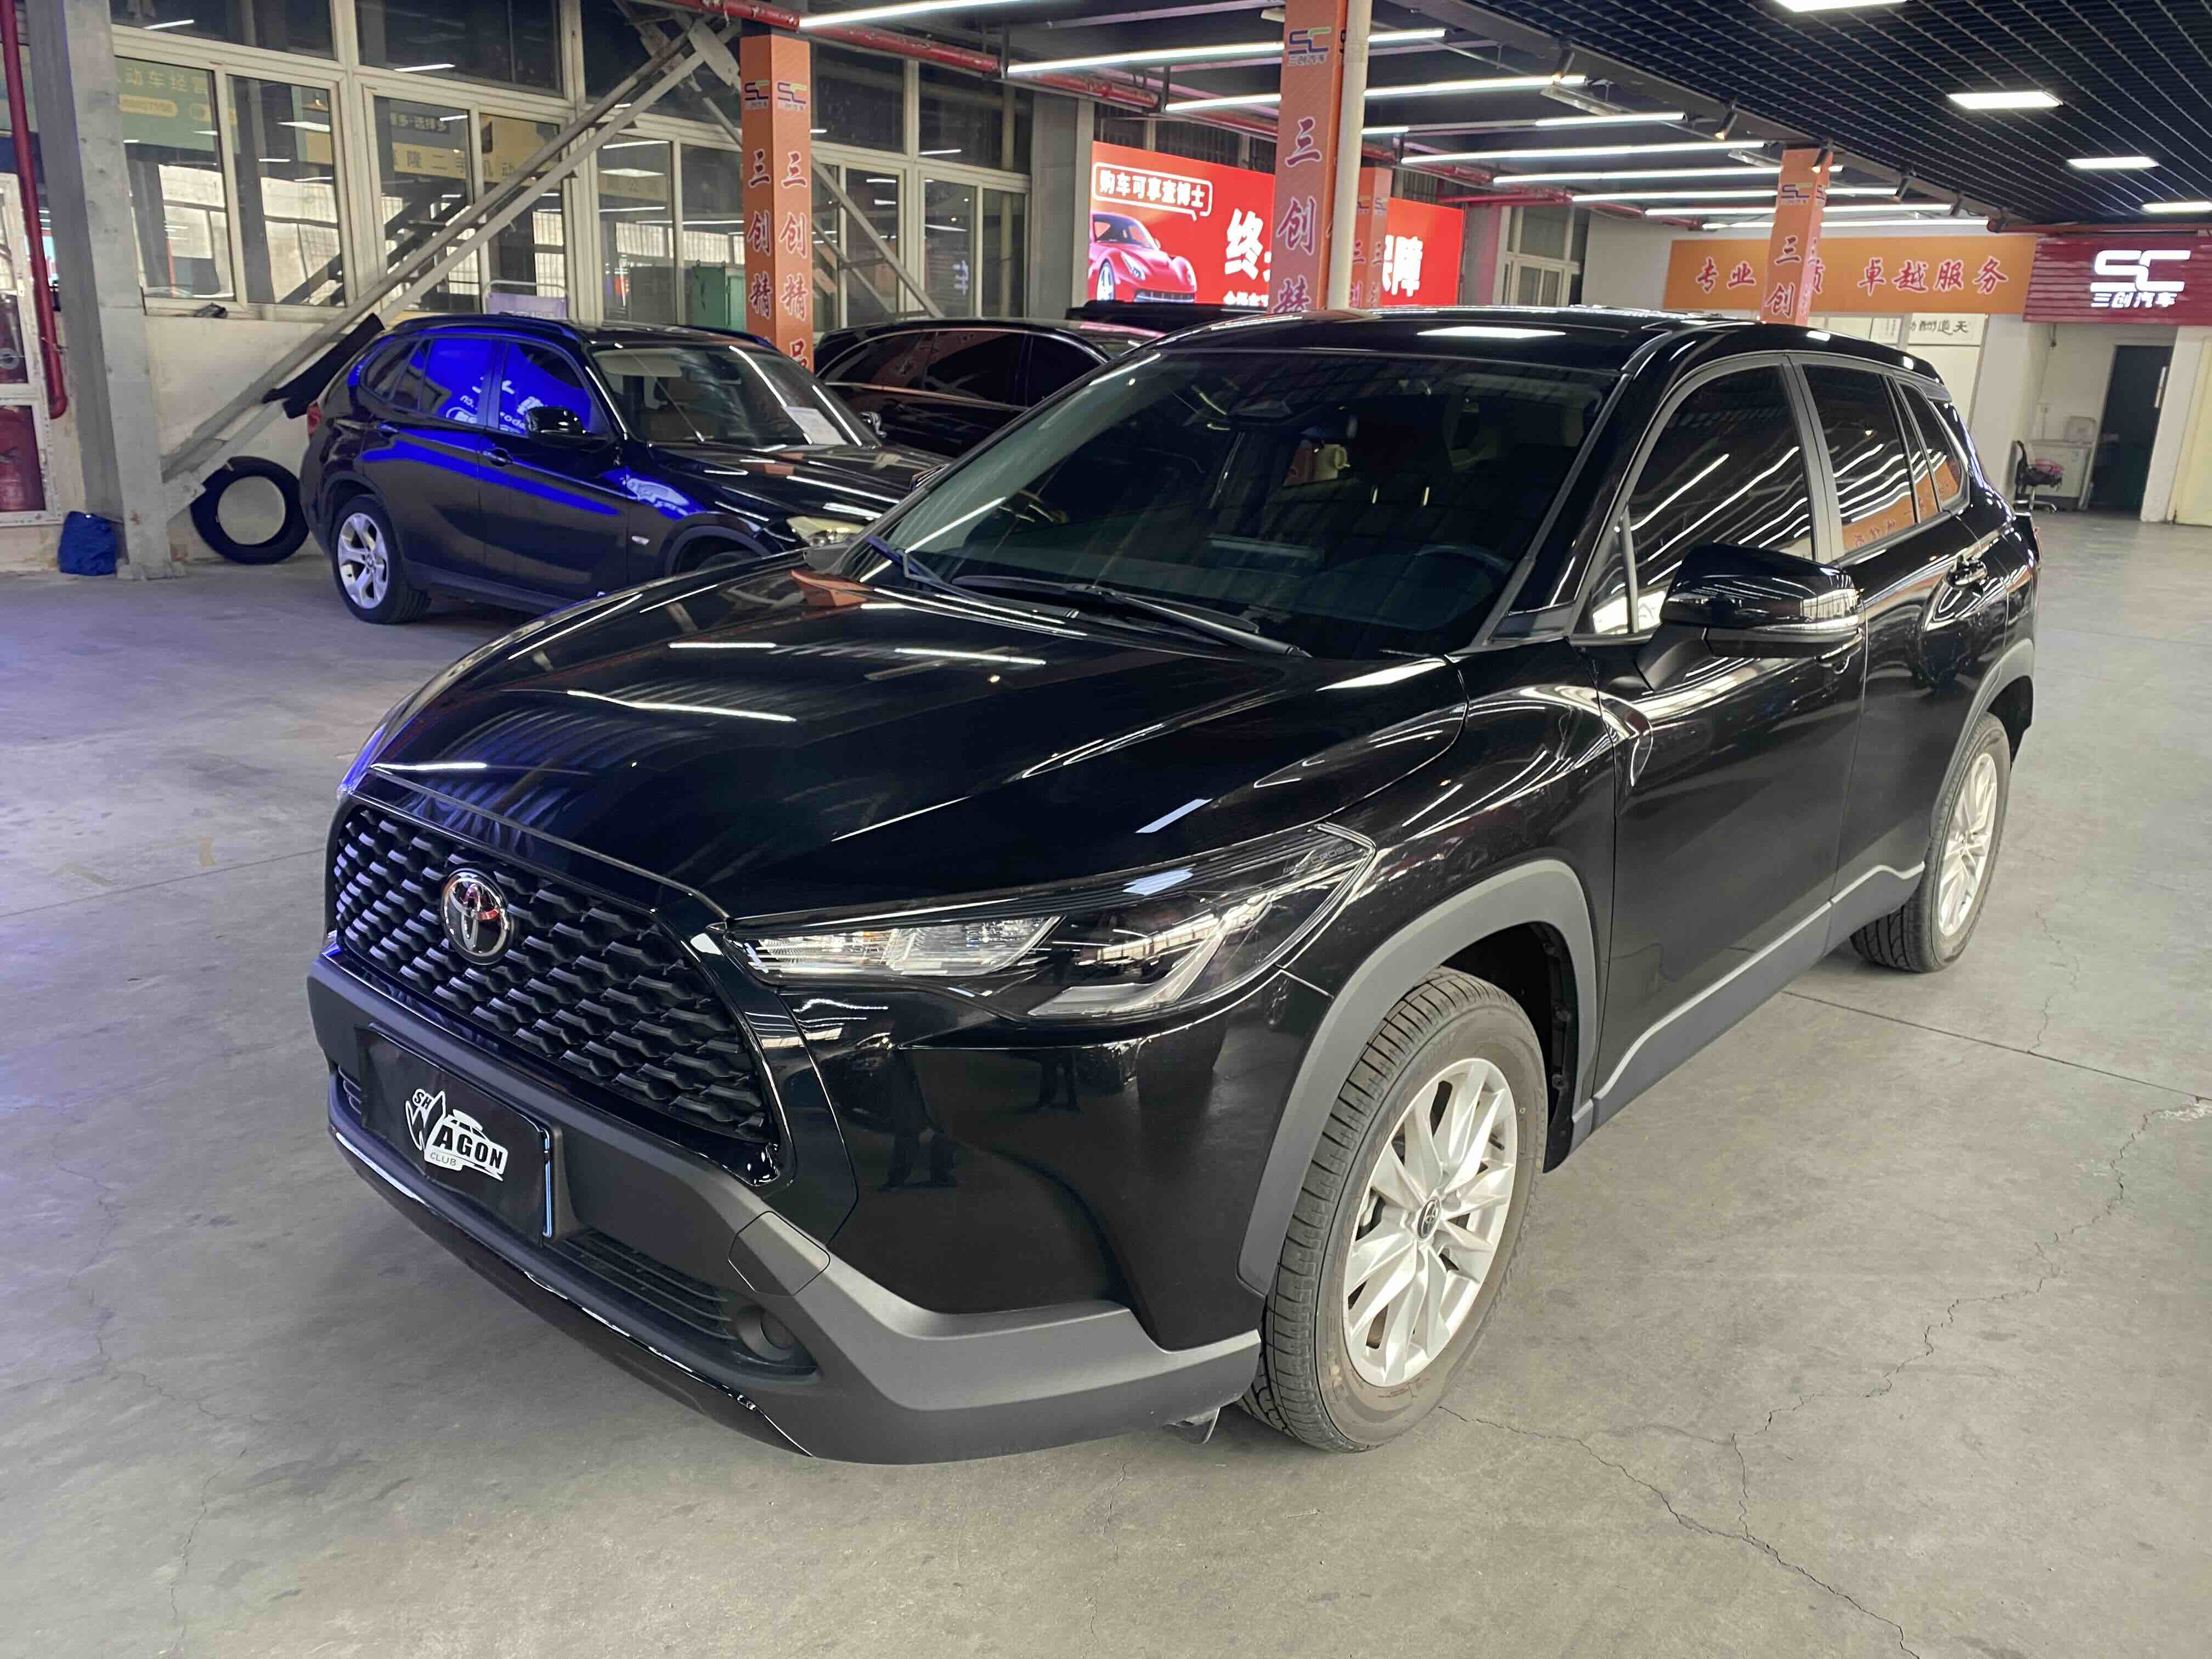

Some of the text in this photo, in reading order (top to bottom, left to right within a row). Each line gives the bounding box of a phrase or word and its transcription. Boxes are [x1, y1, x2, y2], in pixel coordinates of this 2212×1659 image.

[1858, 256, 2008, 296] 卓越服务
[2091, 292, 2177, 308] 三创汽车
[414, 1092, 432, 1108] SH
[430, 1152, 456, 1166] CLUB
